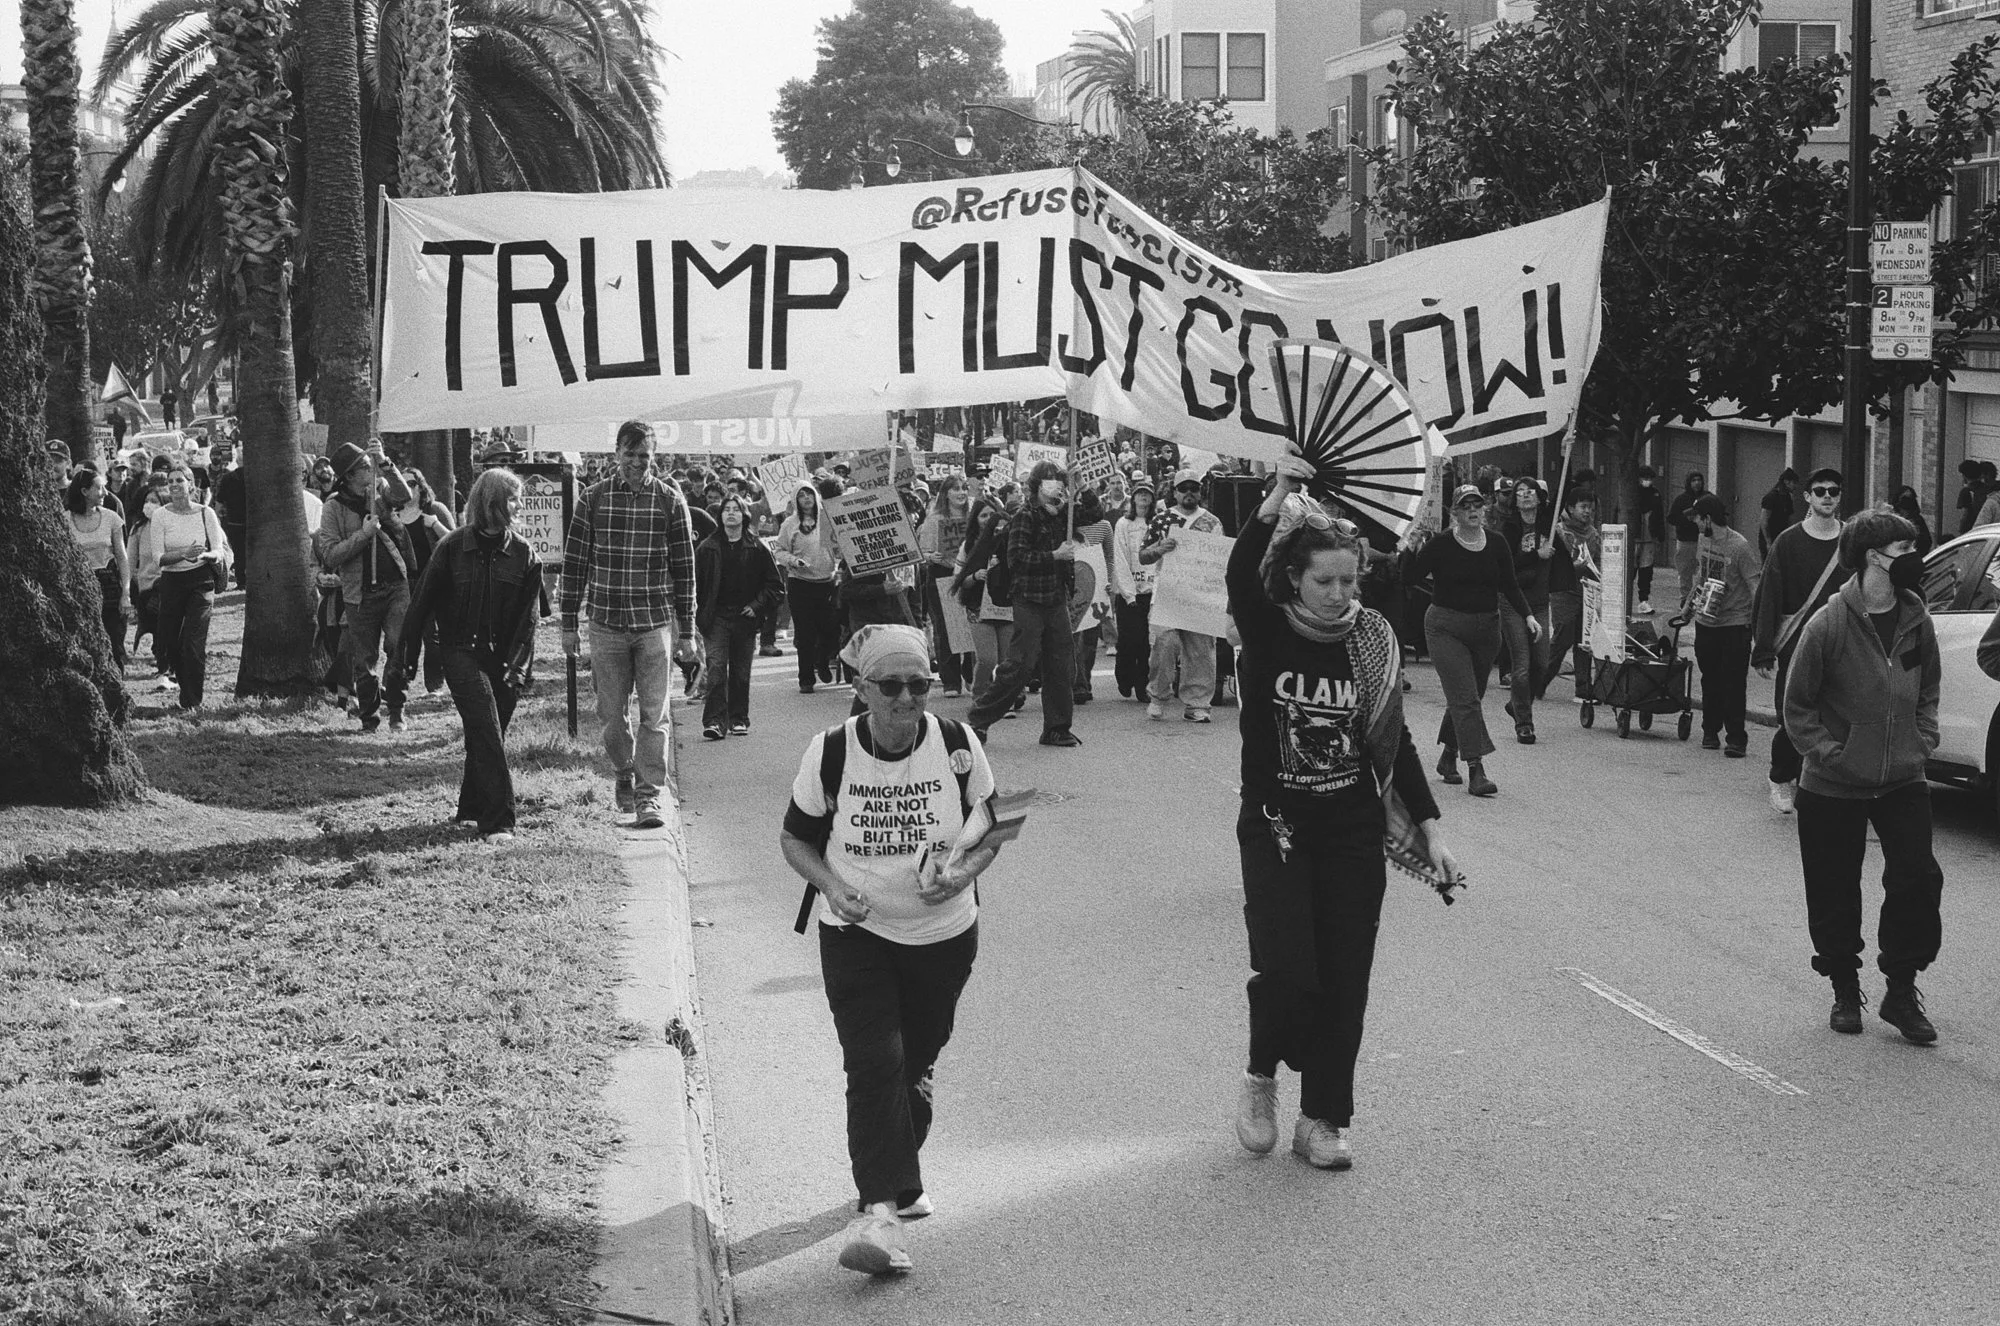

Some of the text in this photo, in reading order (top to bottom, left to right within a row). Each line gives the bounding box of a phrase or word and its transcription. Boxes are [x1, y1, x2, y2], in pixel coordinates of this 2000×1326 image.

[1874, 224, 1928, 240] NO PARKING
[1875, 259, 1926, 270] WEDNESDAY
[1877, 290, 1924, 305] 2 HOUR
[1893, 301, 1930, 309] PARKING
[1879, 325, 1895, 333] MON
[1912, 325, 1925, 333] FRI
[421, 236, 850, 391] TRUMP
[899, 237, 1166, 392] MUST
[1176, 294, 1294, 439] GO
[1081, 460, 1106, 471] MERICA
[832, 502, 899, 526] WE WON'T WAIT
[855, 512, 902, 531] MIDTERMS
[850, 528, 899, 546] THE PEOPLE
[854, 554, 869, 563] ICE
[869, 549, 885, 560] OUT
[885, 543, 909, 557] NOW!
[859, 538, 895, 554] DEMAND
[1277, 773, 1294, 781] CAT
[1311, 776, 1358, 793] SUPREMAC
[849, 780, 942, 798] IMMIGRANTS
[863, 797, 929, 813] ARE NOT
[850, 813, 940, 829] CRIMINALS,
[863, 829, 927, 843] BUT THE
[845, 840, 949, 857] PRESIDEN IS.
